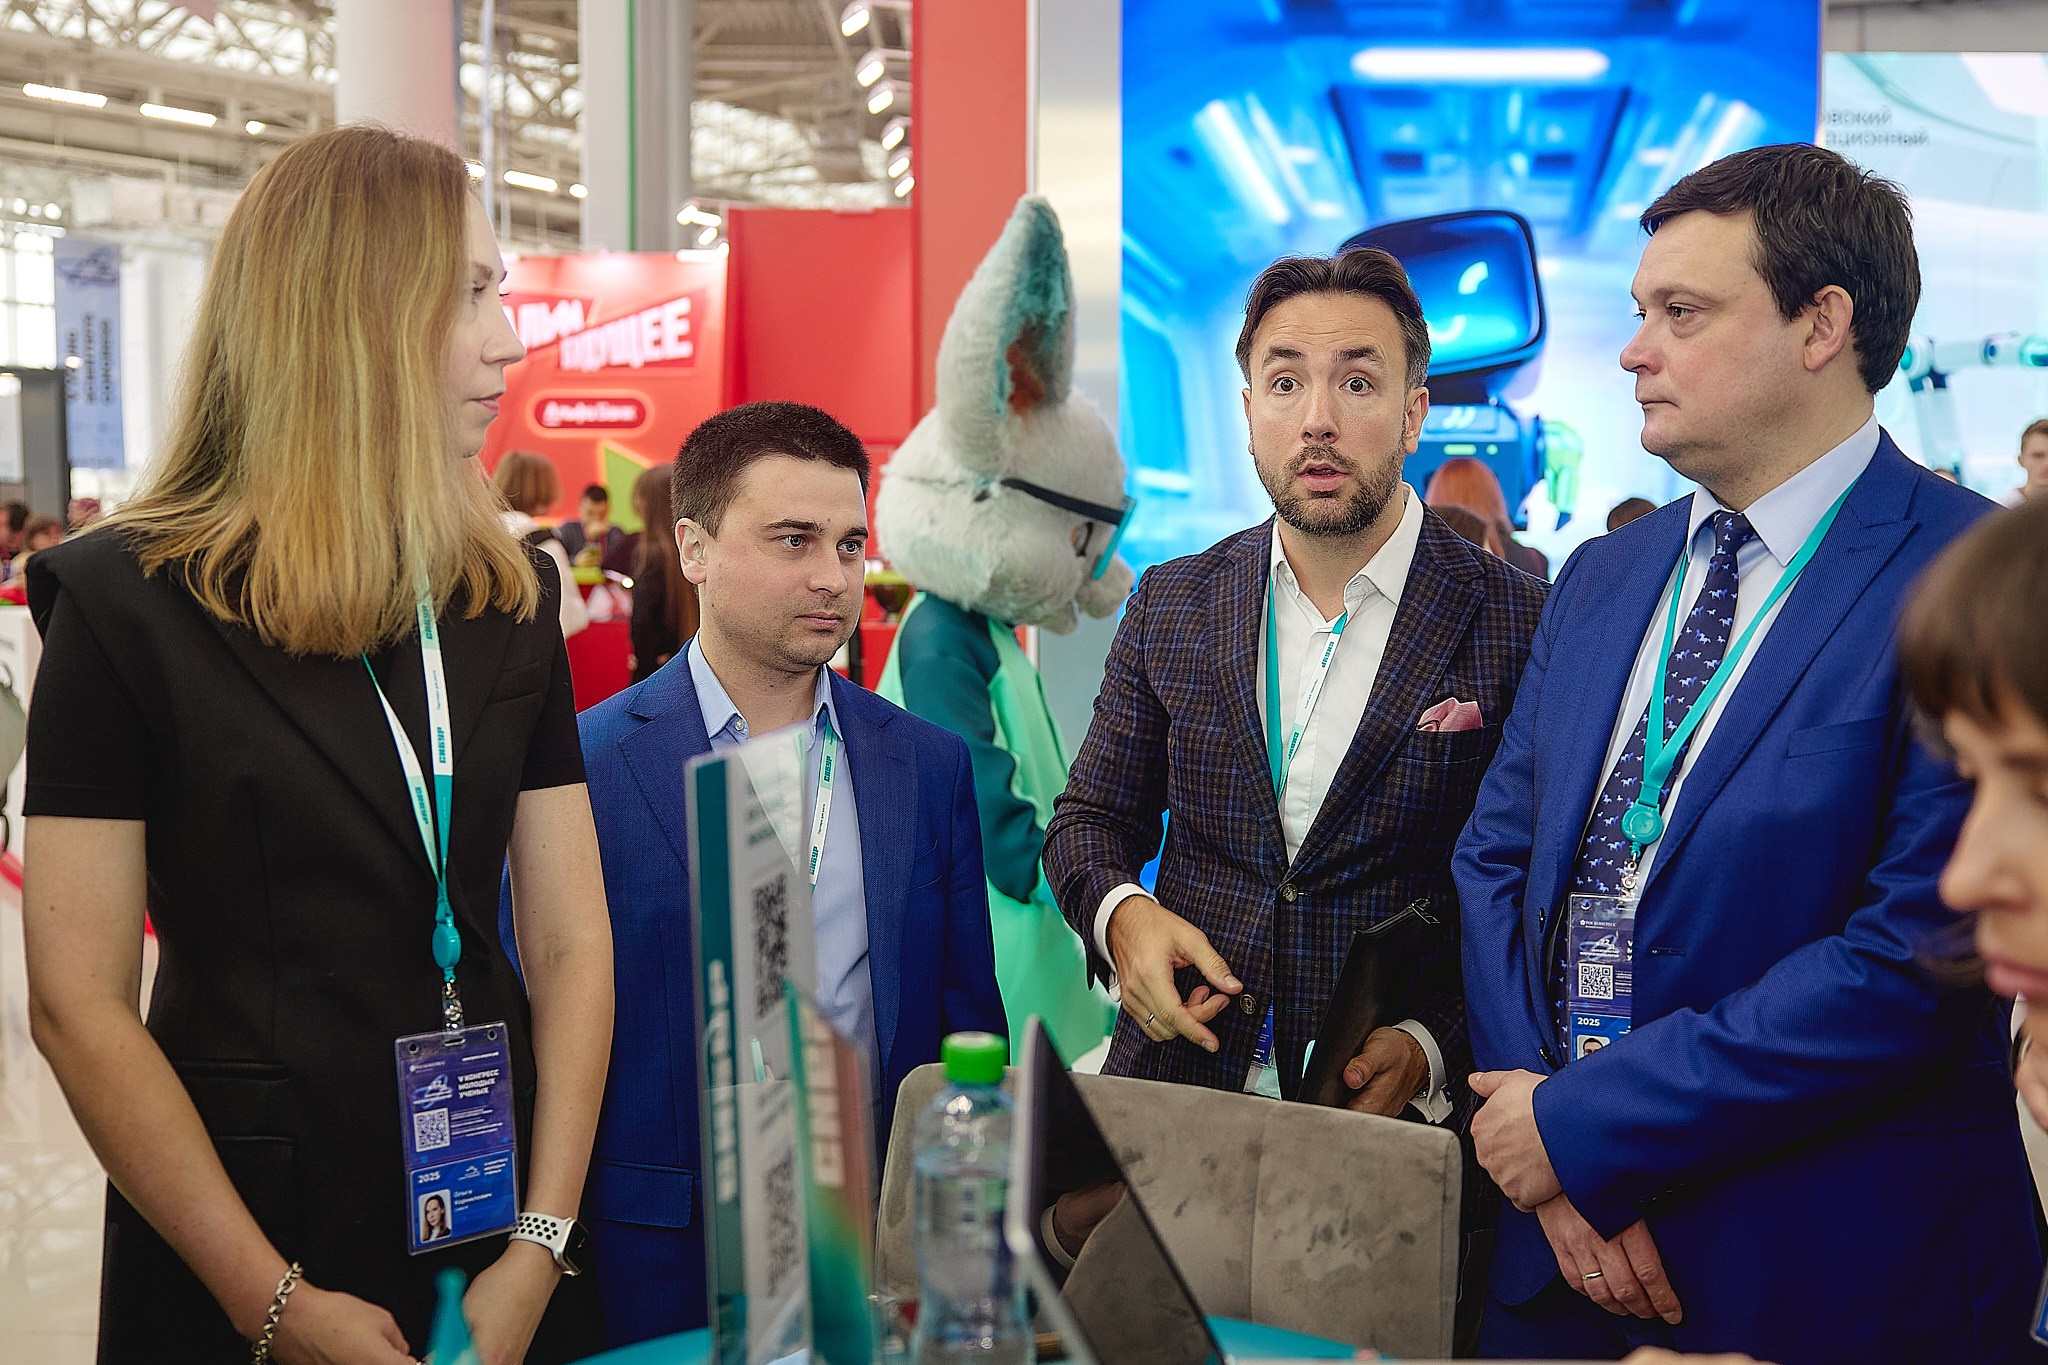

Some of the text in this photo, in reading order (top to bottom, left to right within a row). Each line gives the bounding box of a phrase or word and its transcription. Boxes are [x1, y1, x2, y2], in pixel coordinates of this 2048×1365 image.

[436, 727, 447, 763] СИБУР
[823, 755, 833, 782] СИБУР
[1577, 1017, 1600, 1027] 2025
[418, 1172, 441, 1184] 2025
